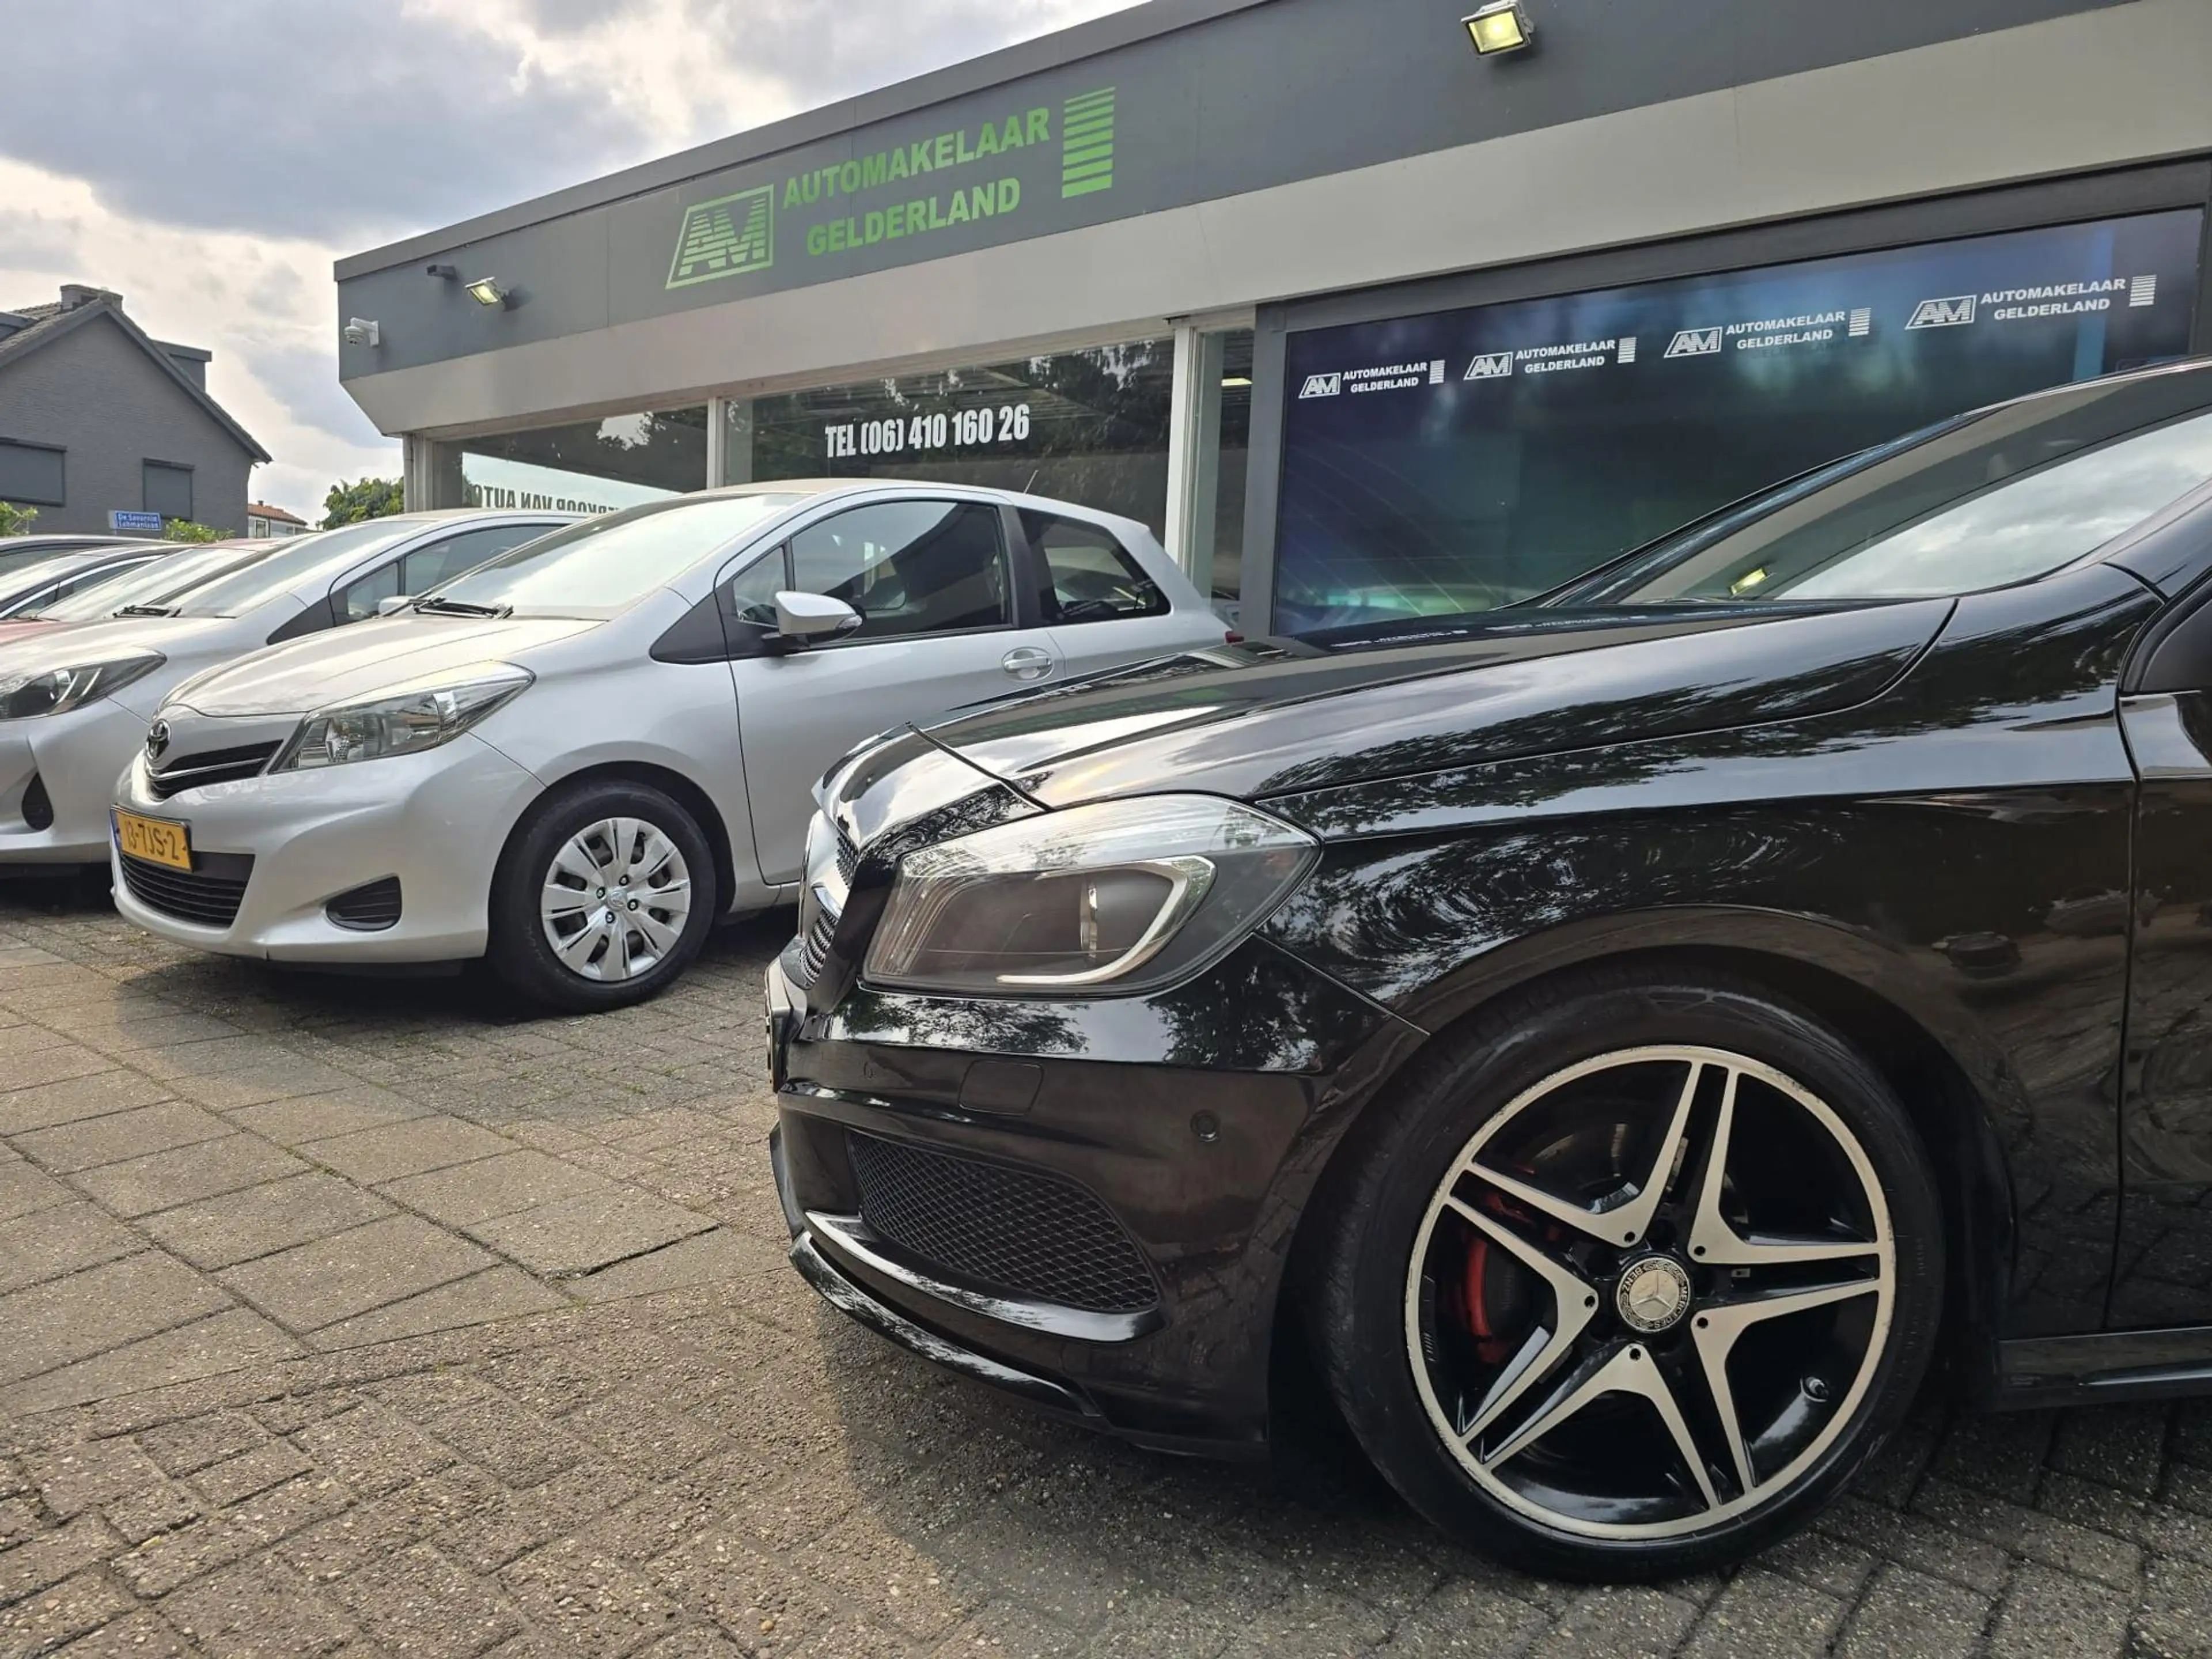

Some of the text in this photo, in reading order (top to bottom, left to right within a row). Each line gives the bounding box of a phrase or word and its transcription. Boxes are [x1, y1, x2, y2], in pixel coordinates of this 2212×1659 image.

[783, 107, 1050, 209] AUTOMAKELAAR
[808, 178, 1020, 255] GELDERLAND
[1980, 278, 2126, 304] AUTOMAKELAAR
[1912, 298, 1972, 327] AM
[1994, 298, 2110, 320] GELDERLAND
[1726, 311, 1846, 335] AUTOMAKELAAR
[1516, 340, 1615, 360] AUTOMAKELAAR
[1670, 329, 1719, 354] AM
[1736, 329, 1832, 349] GELDERLAND
[1342, 362, 1427, 380] AUTOMAKELAAR
[1469, 355, 1510, 376] AM
[1525, 357, 1605, 373] GELDERLAND
[1304, 376, 1338, 396] AM
[1350, 378, 1419, 393] GELDERLAND
[825, 404, 1030, 458] TEL (06) 410 160 26
[1622, 1268, 1643, 1292] BENZ
